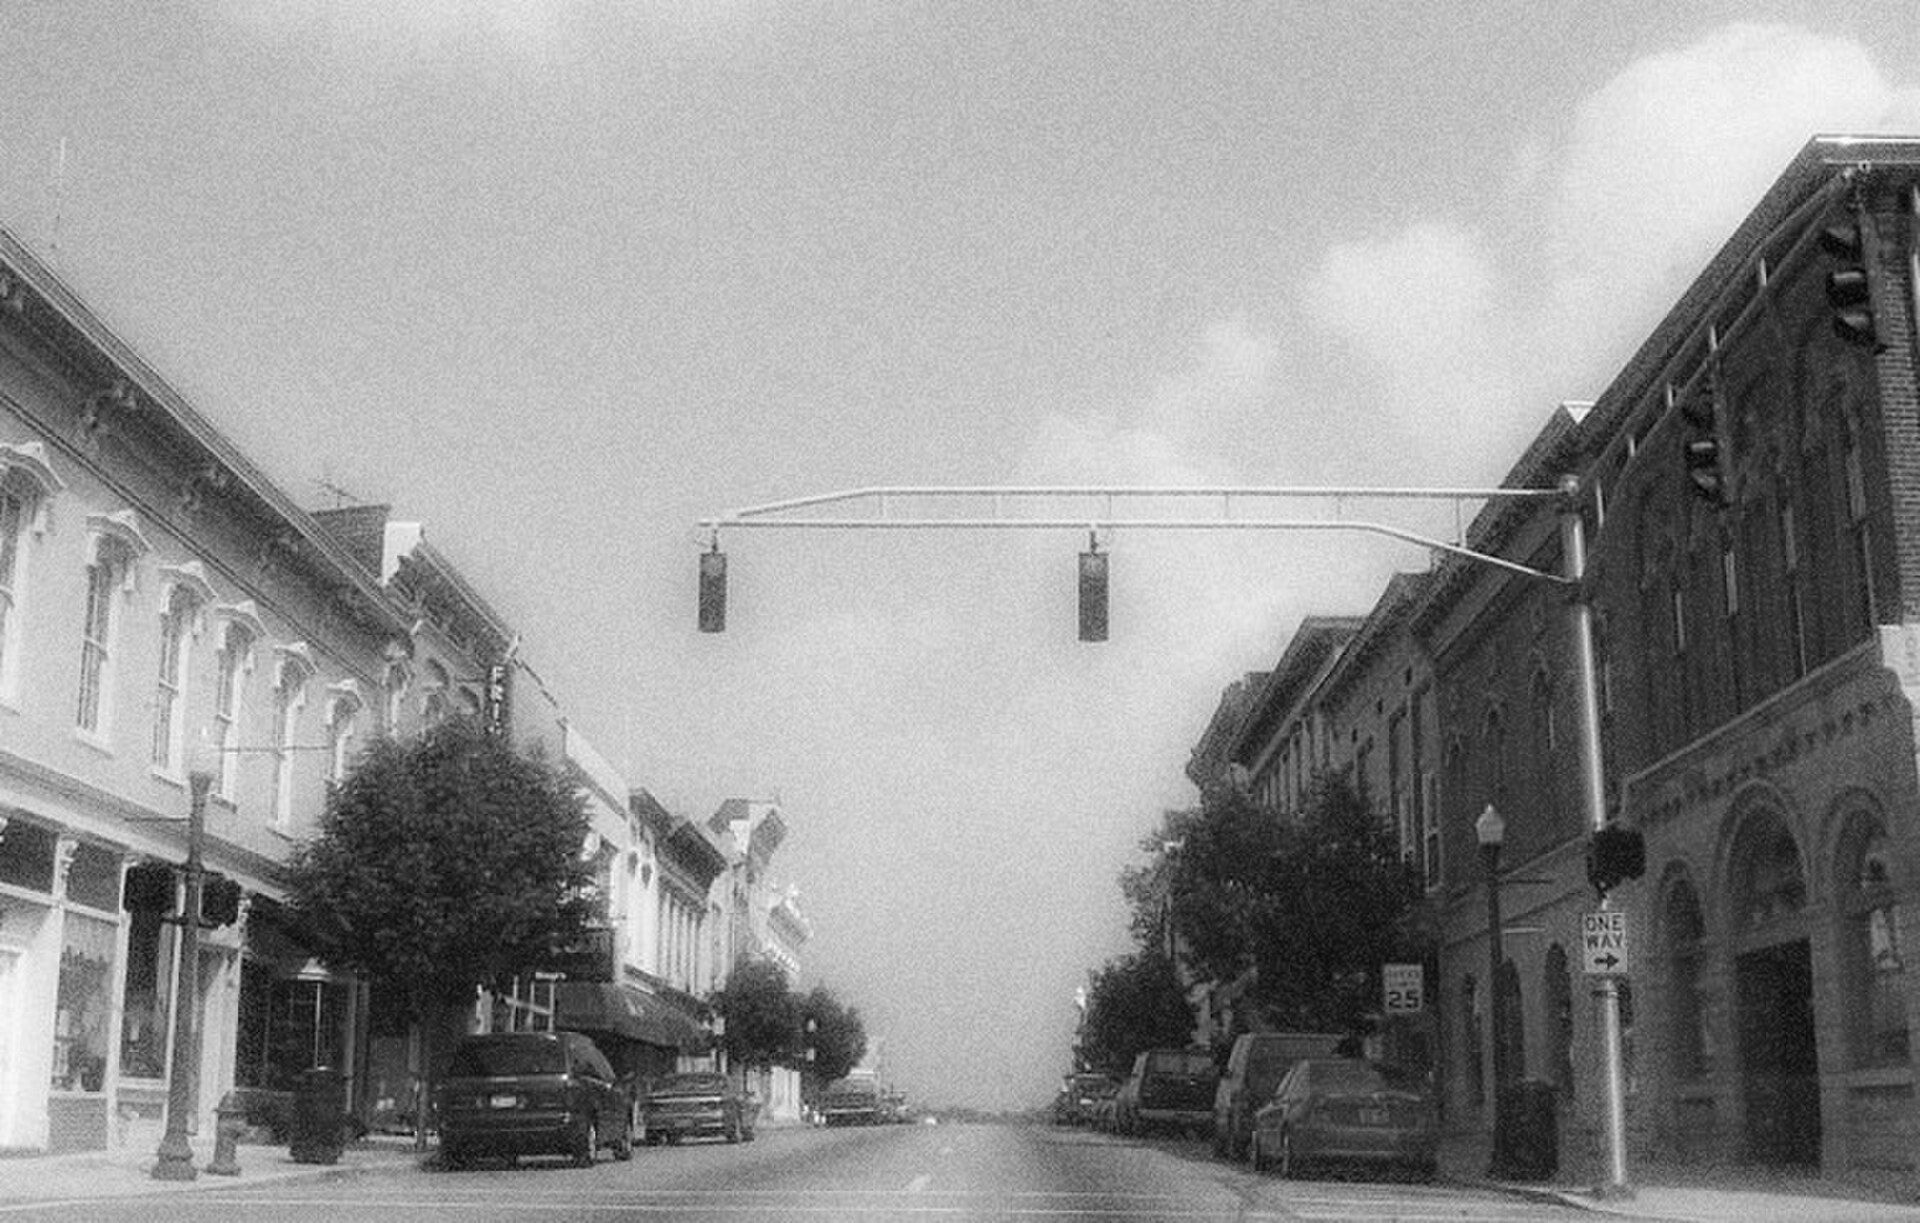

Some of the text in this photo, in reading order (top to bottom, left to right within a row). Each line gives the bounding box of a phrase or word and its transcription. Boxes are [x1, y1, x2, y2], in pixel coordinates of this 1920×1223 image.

[1586, 914, 1622, 931] ONE
[1586, 933, 1623, 949] WAY
[1388, 990, 1419, 1009] 25
